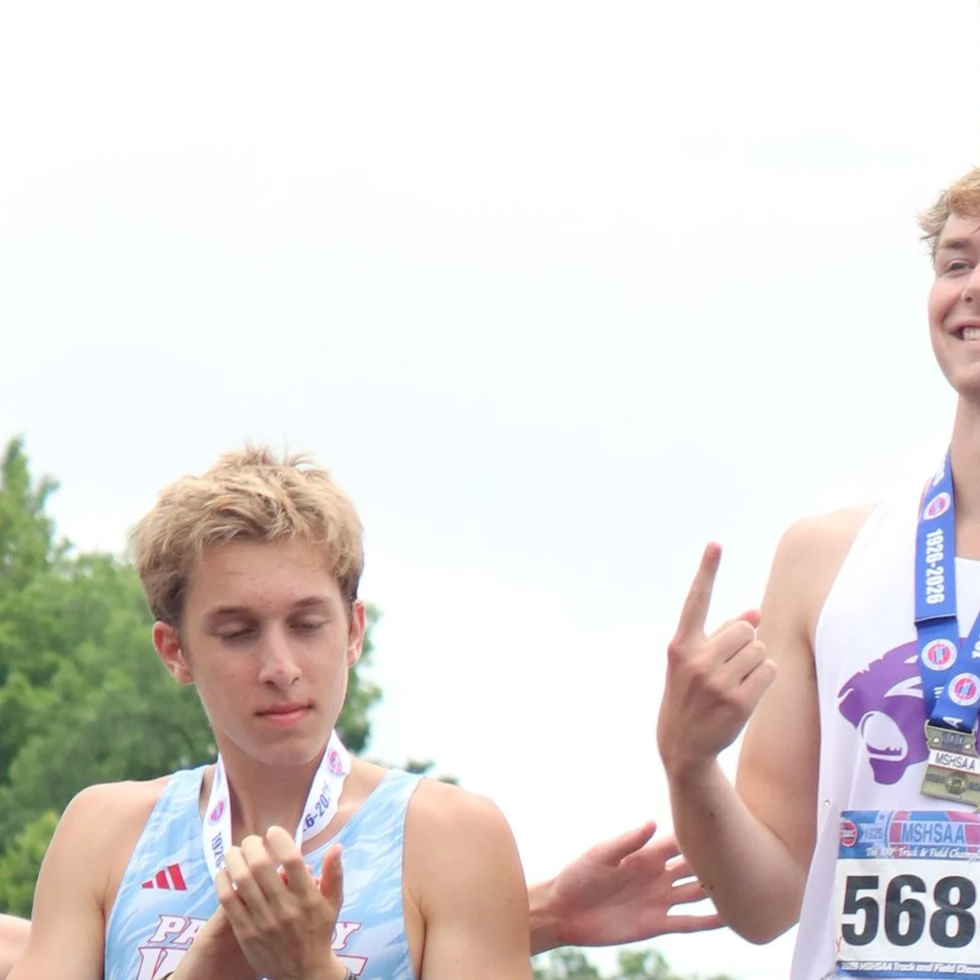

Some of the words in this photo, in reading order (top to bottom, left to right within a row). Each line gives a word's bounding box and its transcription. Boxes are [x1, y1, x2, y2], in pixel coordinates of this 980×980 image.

[924, 528, 946, 605] 1926-2026
[934, 751, 976, 771] MSHSAA
[901, 822, 966, 844] MSHSAA
